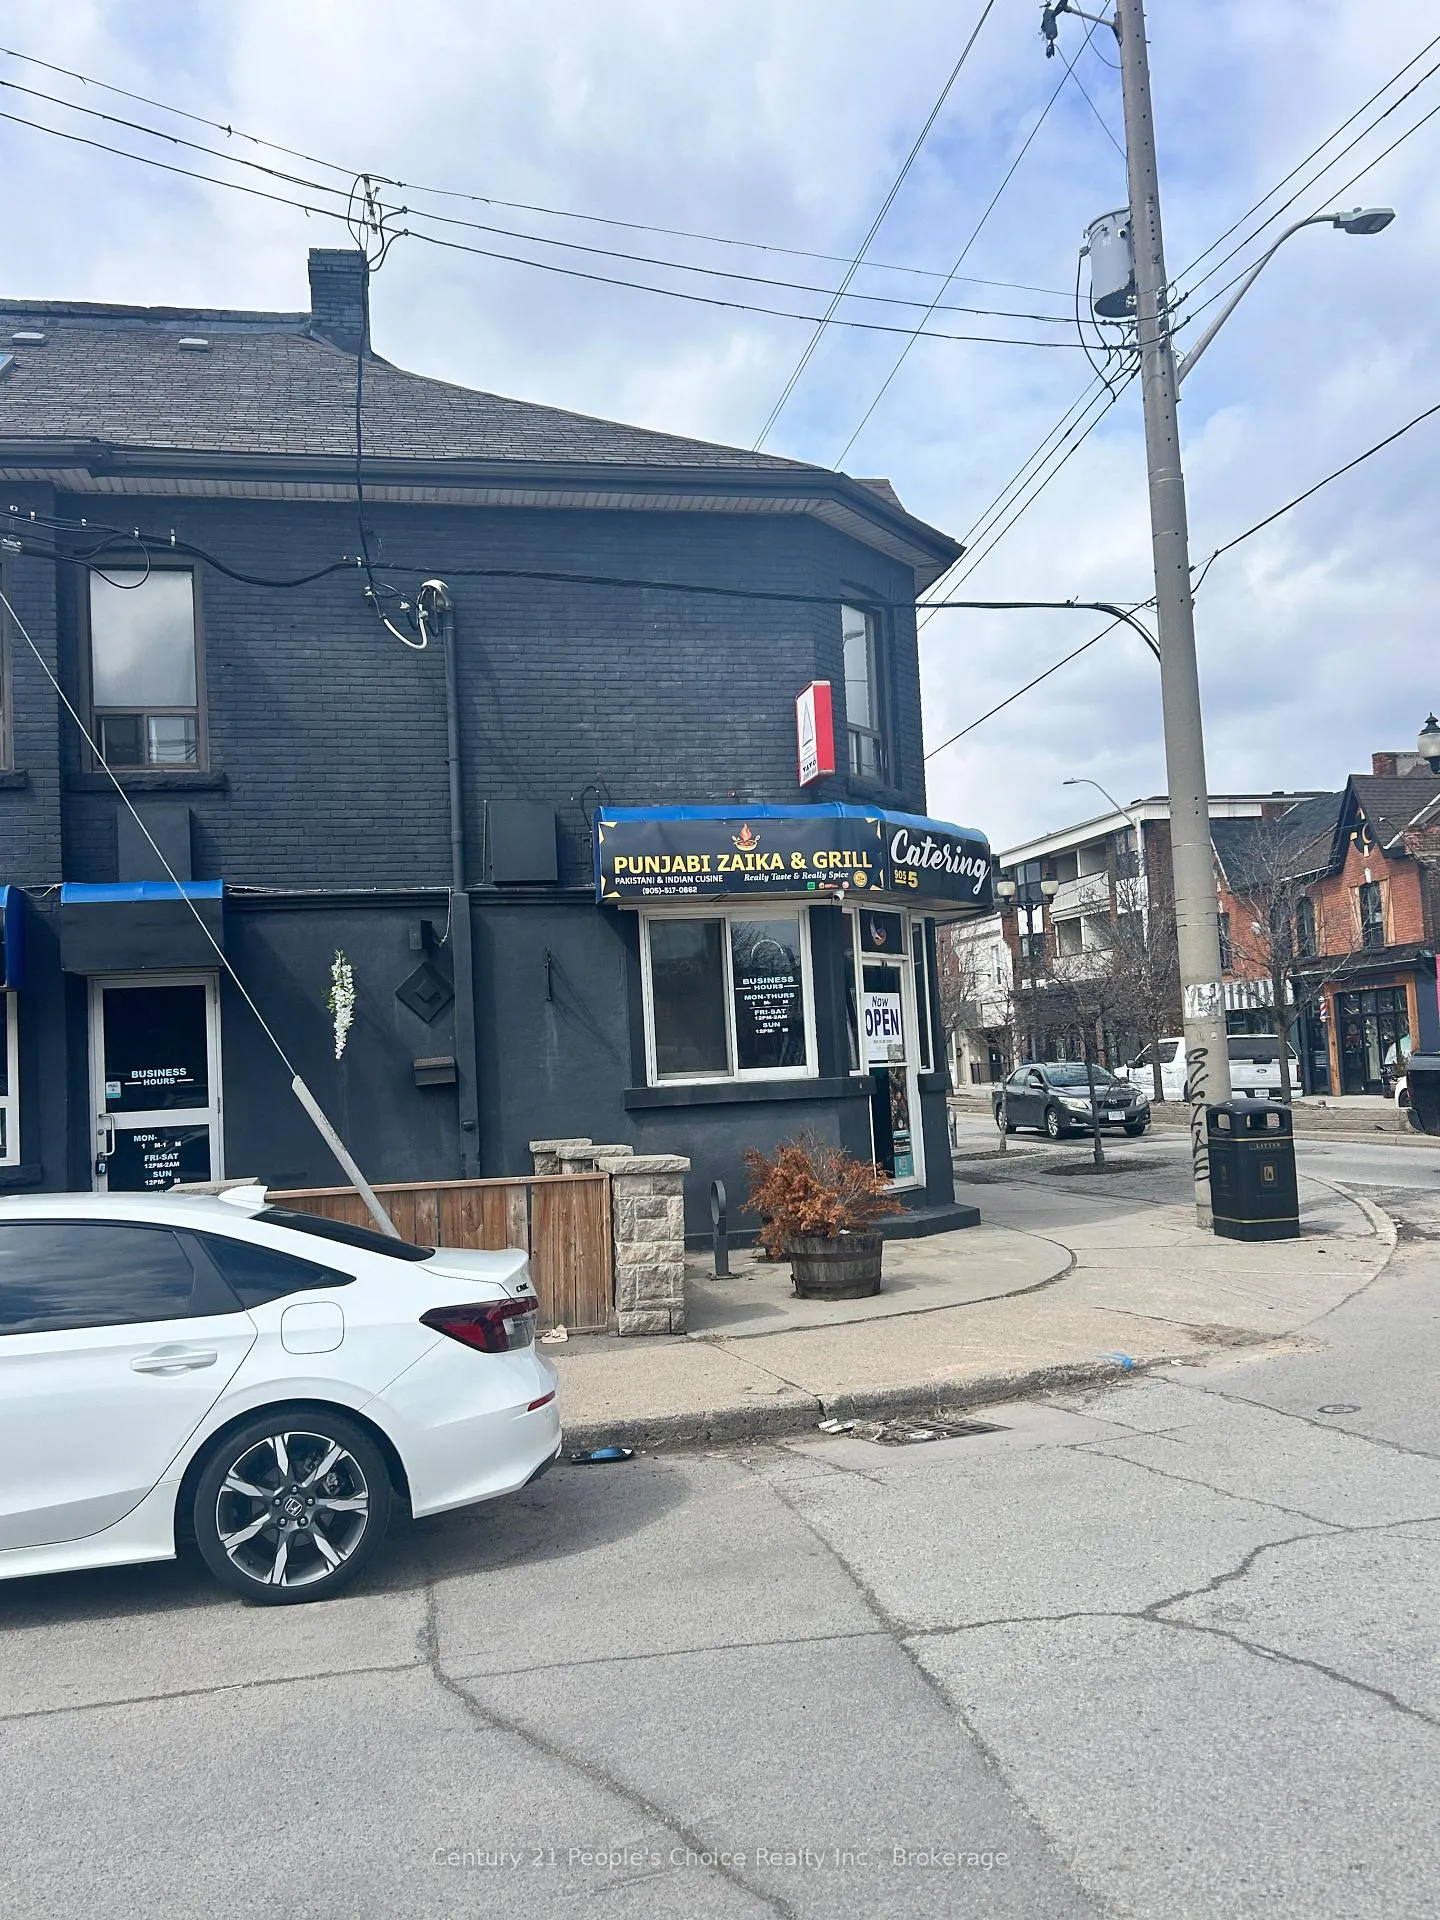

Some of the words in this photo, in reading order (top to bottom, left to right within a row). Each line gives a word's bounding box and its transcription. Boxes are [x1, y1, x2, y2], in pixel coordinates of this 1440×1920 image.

[614, 855, 711, 874] PUNJABI
[717, 852, 785, 872] ZAIKA
[790, 852, 808, 869] &
[812, 851, 873, 868] GRILL
[891, 829, 990, 895] Catering
[615, 876, 655, 885] PAKISTANI
[665, 875, 694, 884] INDIAN
[695, 874, 724, 883] CUSINE
[744, 873, 770, 882] Really
[771, 872, 791, 881] Taste
[793, 872, 800, 880] &
[802, 871, 826, 881] Really
[828, 870, 849, 880] Spice
[894, 869, 907, 880] 905
[908, 870, 918, 888] 5
[742, 976, 794, 985] BUSINESS
[744, 992, 795, 1000] MON-THURS
[754, 1008, 787, 1016] FRI-SAT
[865, 1008, 900, 1037] OPEN
[131, 1067, 187, 1079] BUSINESS
[143, 1078, 176, 1086] HOURS
[133, 1134, 158, 1143] MON-
[144, 1152, 179, 1162] FRI-SAT
[143, 1161, 180, 1169] 12PM-2AM
[152, 1170, 172, 1178] SUN
